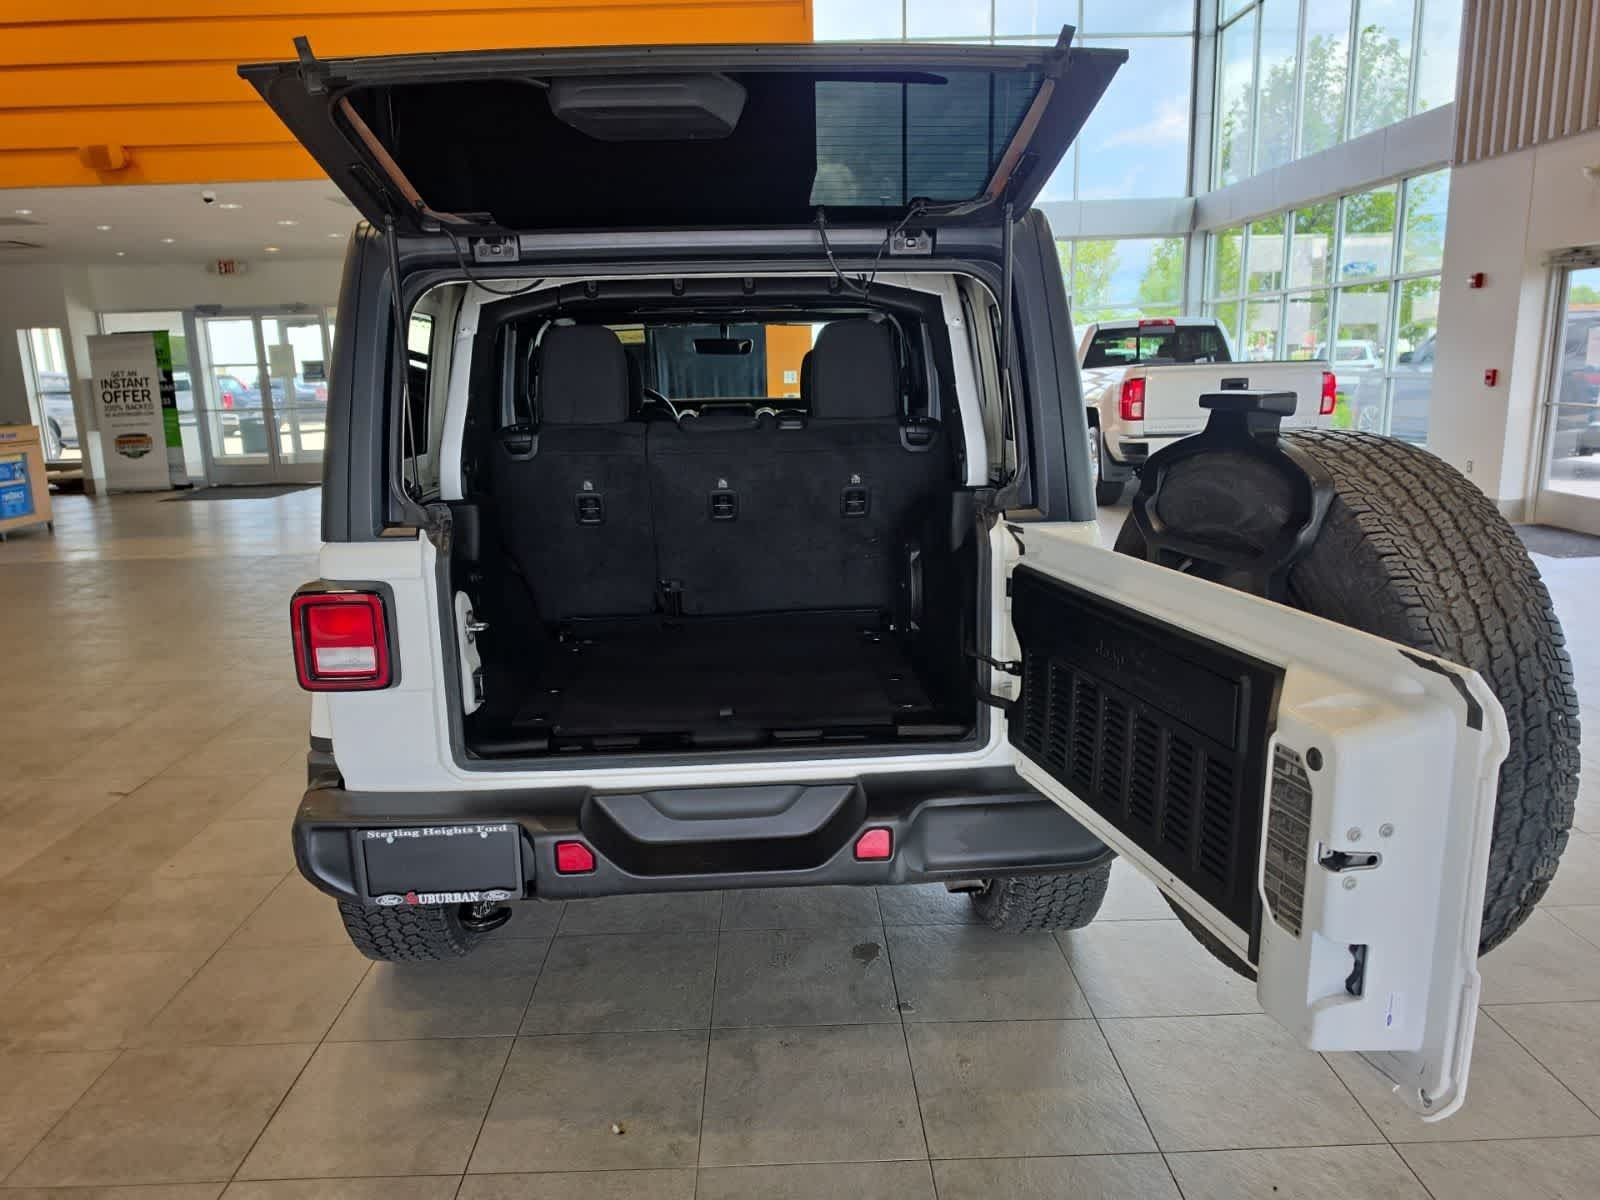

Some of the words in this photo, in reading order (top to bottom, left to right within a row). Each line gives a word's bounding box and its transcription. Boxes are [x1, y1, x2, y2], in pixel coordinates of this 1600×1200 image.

[100, 377, 150, 389] INSTANT
[102, 388, 152, 404] OFFER
[367, 829, 420, 839] Sterling
[423, 826, 474, 836] Heights
[477, 824, 507, 833] Ford
[405, 890, 480, 905] SUBURBAN
